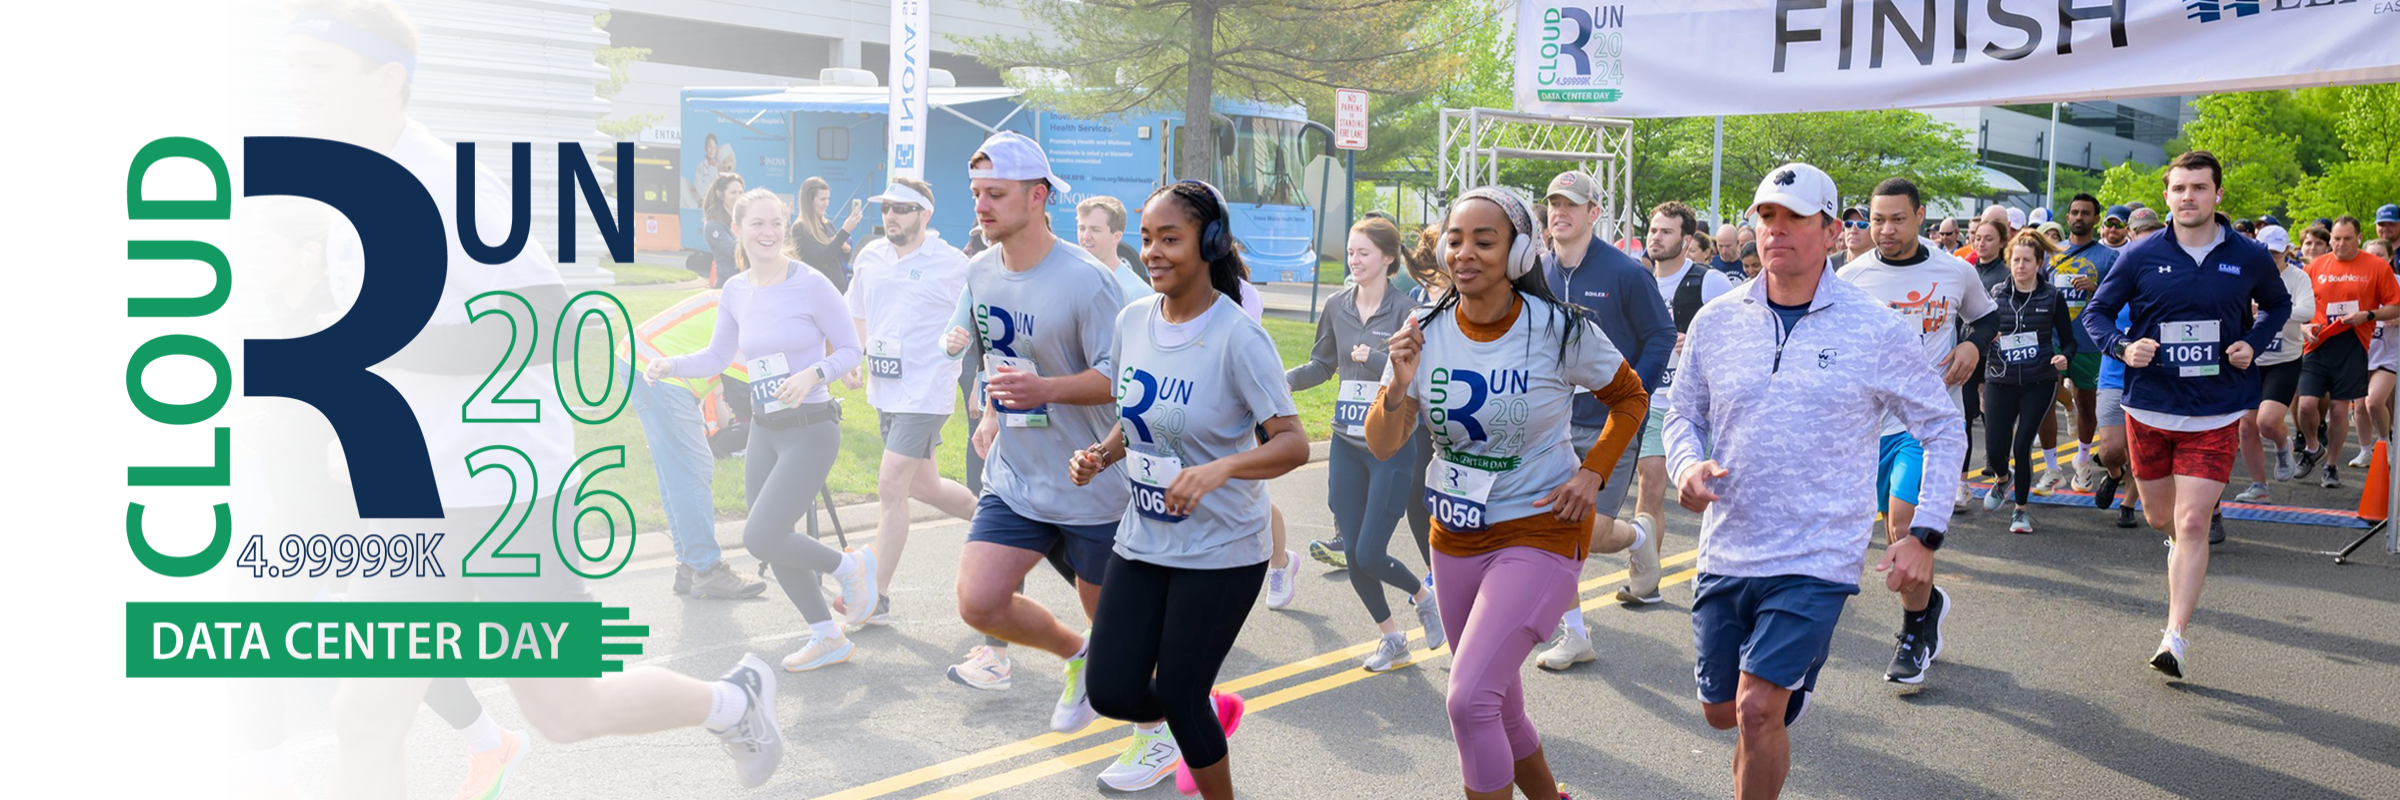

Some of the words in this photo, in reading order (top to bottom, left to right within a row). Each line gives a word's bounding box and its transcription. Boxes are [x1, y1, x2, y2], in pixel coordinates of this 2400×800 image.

[1593, 32, 1623, 58] 20
[1772, 0, 2128, 73] FINISH
[1537, 8, 1561, 86] CLOUD
[1592, 59, 1624, 86] 24
[1347, 94, 1357, 103] NO
[1541, 92, 1560, 101] DATA
[1561, 91, 1593, 101] CENTER
[1593, 90, 1611, 100] DAY
[1341, 103, 1363, 112] PARKING
[1050, 124, 1076, 132] Health
[1078, 124, 1112, 133] Services
[1339, 118, 1365, 129] STANDING
[1350, 130, 1364, 139] LANE
[2005, 347, 2037, 362] 1219
[2166, 344, 2213, 362] 1061
[869, 359, 900, 375] 1192
[1151, 404, 1186, 436] 20
[1340, 404, 1368, 421] 107
[1488, 398, 1529, 427] 20
[1488, 427, 1526, 455] 24
[1489, 460, 1508, 469] DAY
[1133, 485, 1166, 514] 106
[1428, 494, 1481, 528] 1059
